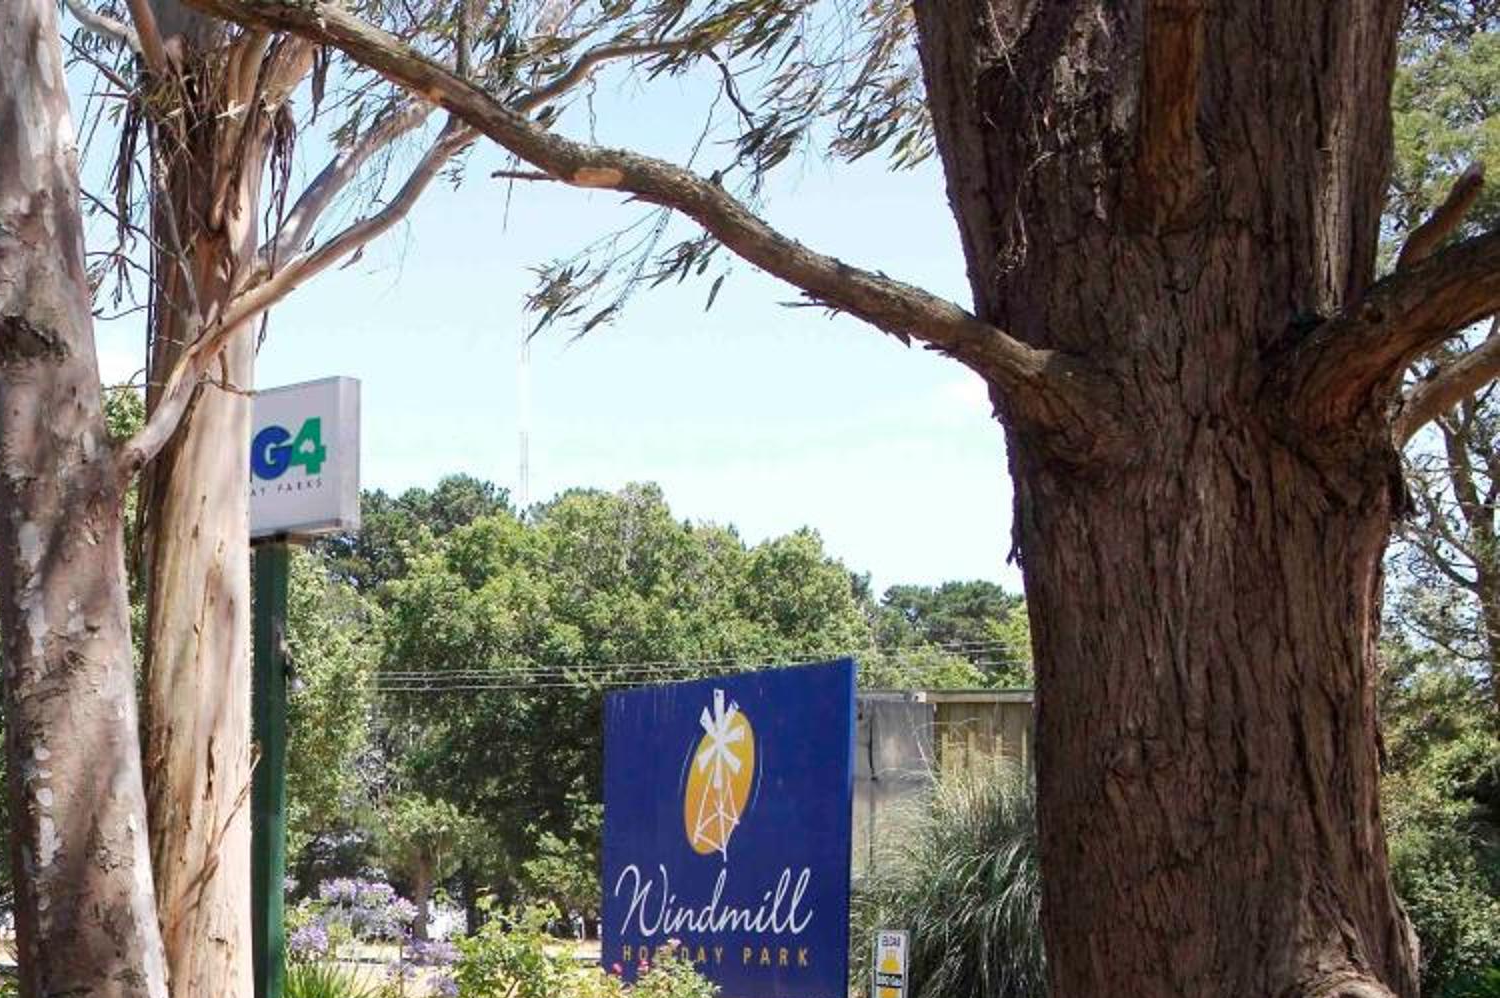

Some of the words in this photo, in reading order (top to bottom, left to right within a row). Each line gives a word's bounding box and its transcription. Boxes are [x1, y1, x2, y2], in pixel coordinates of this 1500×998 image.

[250, 416, 326, 480] G4
[615, 864, 813, 936] Windmill
[622, 945, 724, 965] HODAY
[743, 947, 809, 967] PARK
